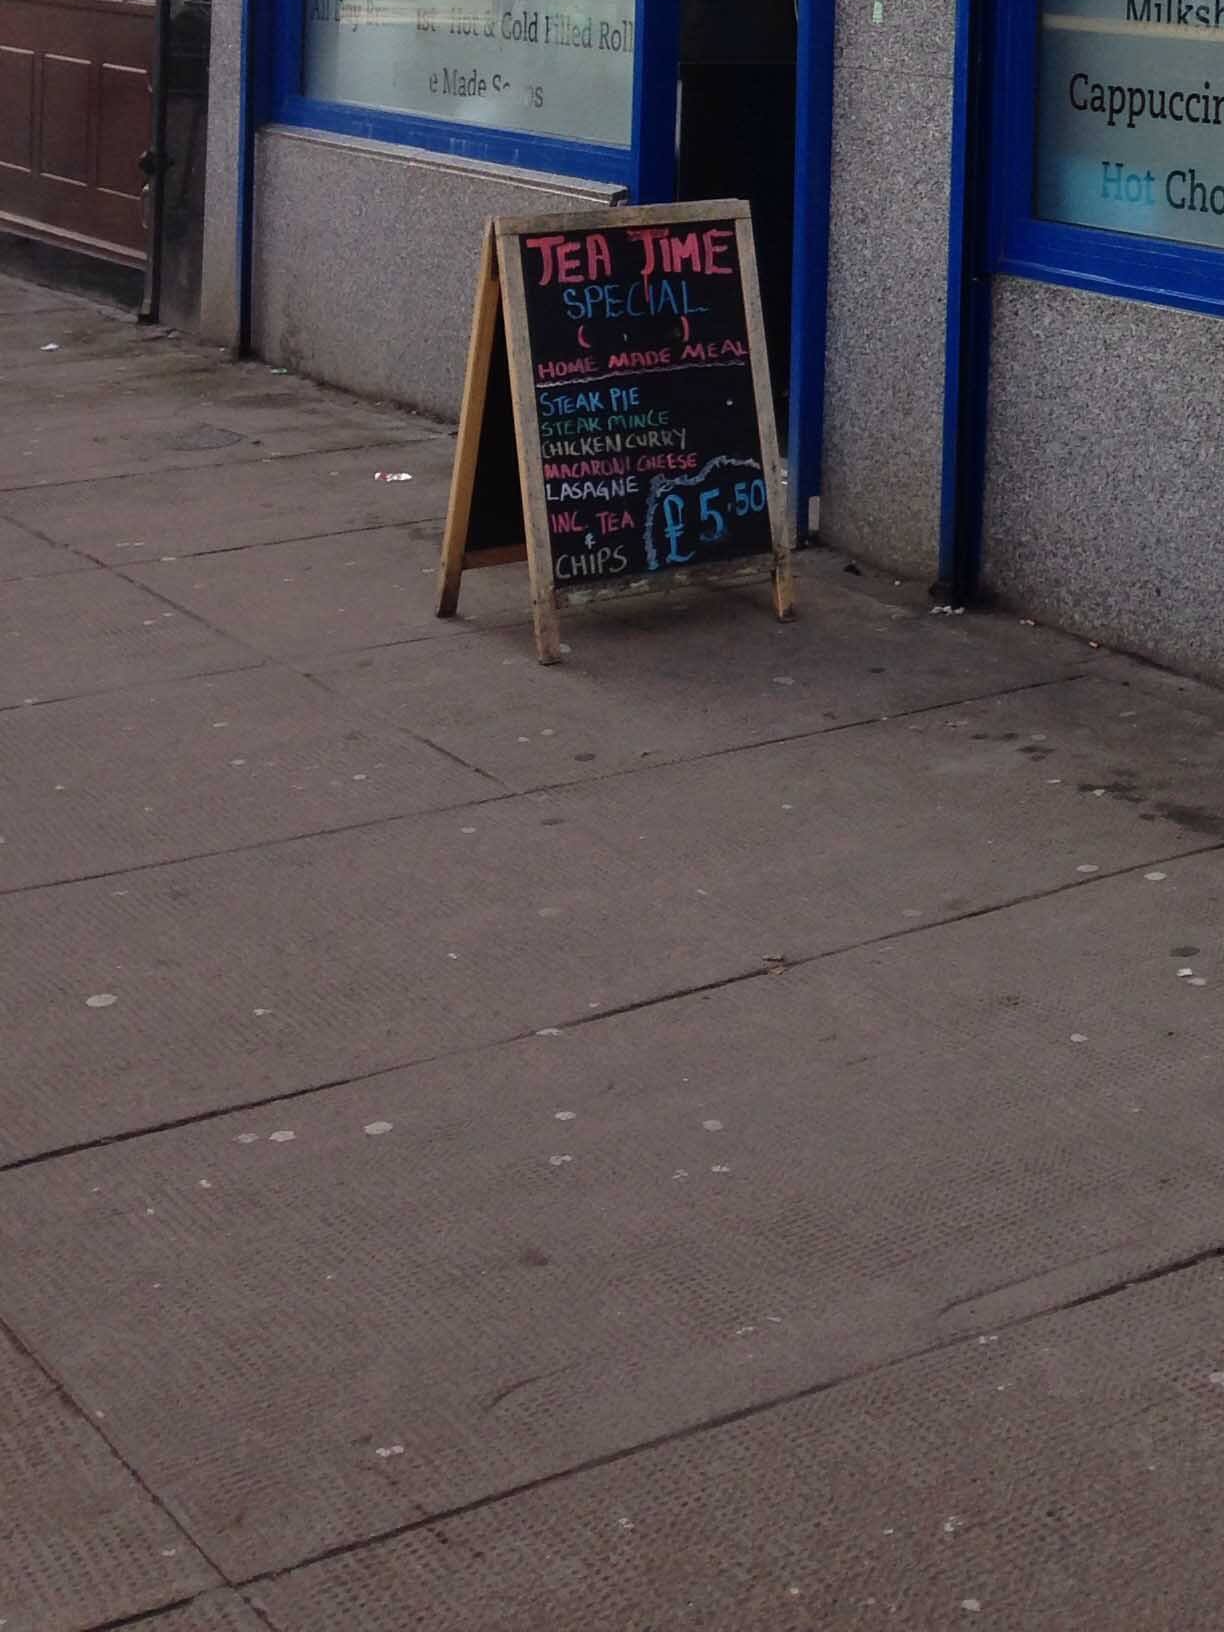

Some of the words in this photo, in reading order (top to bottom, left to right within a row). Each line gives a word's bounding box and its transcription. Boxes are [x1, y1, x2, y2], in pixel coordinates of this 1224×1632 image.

[501, 11, 539, 43] Cold
[544, 14, 593, 50] Filled
[442, 67, 488, 99] Made
[1101, 161, 1156, 207] Hot
[525, 233, 613, 287] TEA
[626, 227, 734, 276] TIME
[562, 279, 709, 320] SPECIAL
[537, 356, 601, 379] HOME
[607, 349, 672, 369] MADE
[681, 338, 749, 361] MEAL
[539, 391, 605, 417] STEAK
[609, 386, 641, 412] PIE
[541, 418, 603, 437] STEAK
[607, 409, 671, 432] MINCE
[541, 433, 622, 459] CHICKEN
[625, 427, 687, 451] CURRY
[543, 457, 630, 480] MACARONI
[636, 452, 698, 473] CHEESE
[545, 475, 640, 503] LASAGNE
[596, 510, 635, 535] TEA
[555, 544, 629, 580] CHIPS
